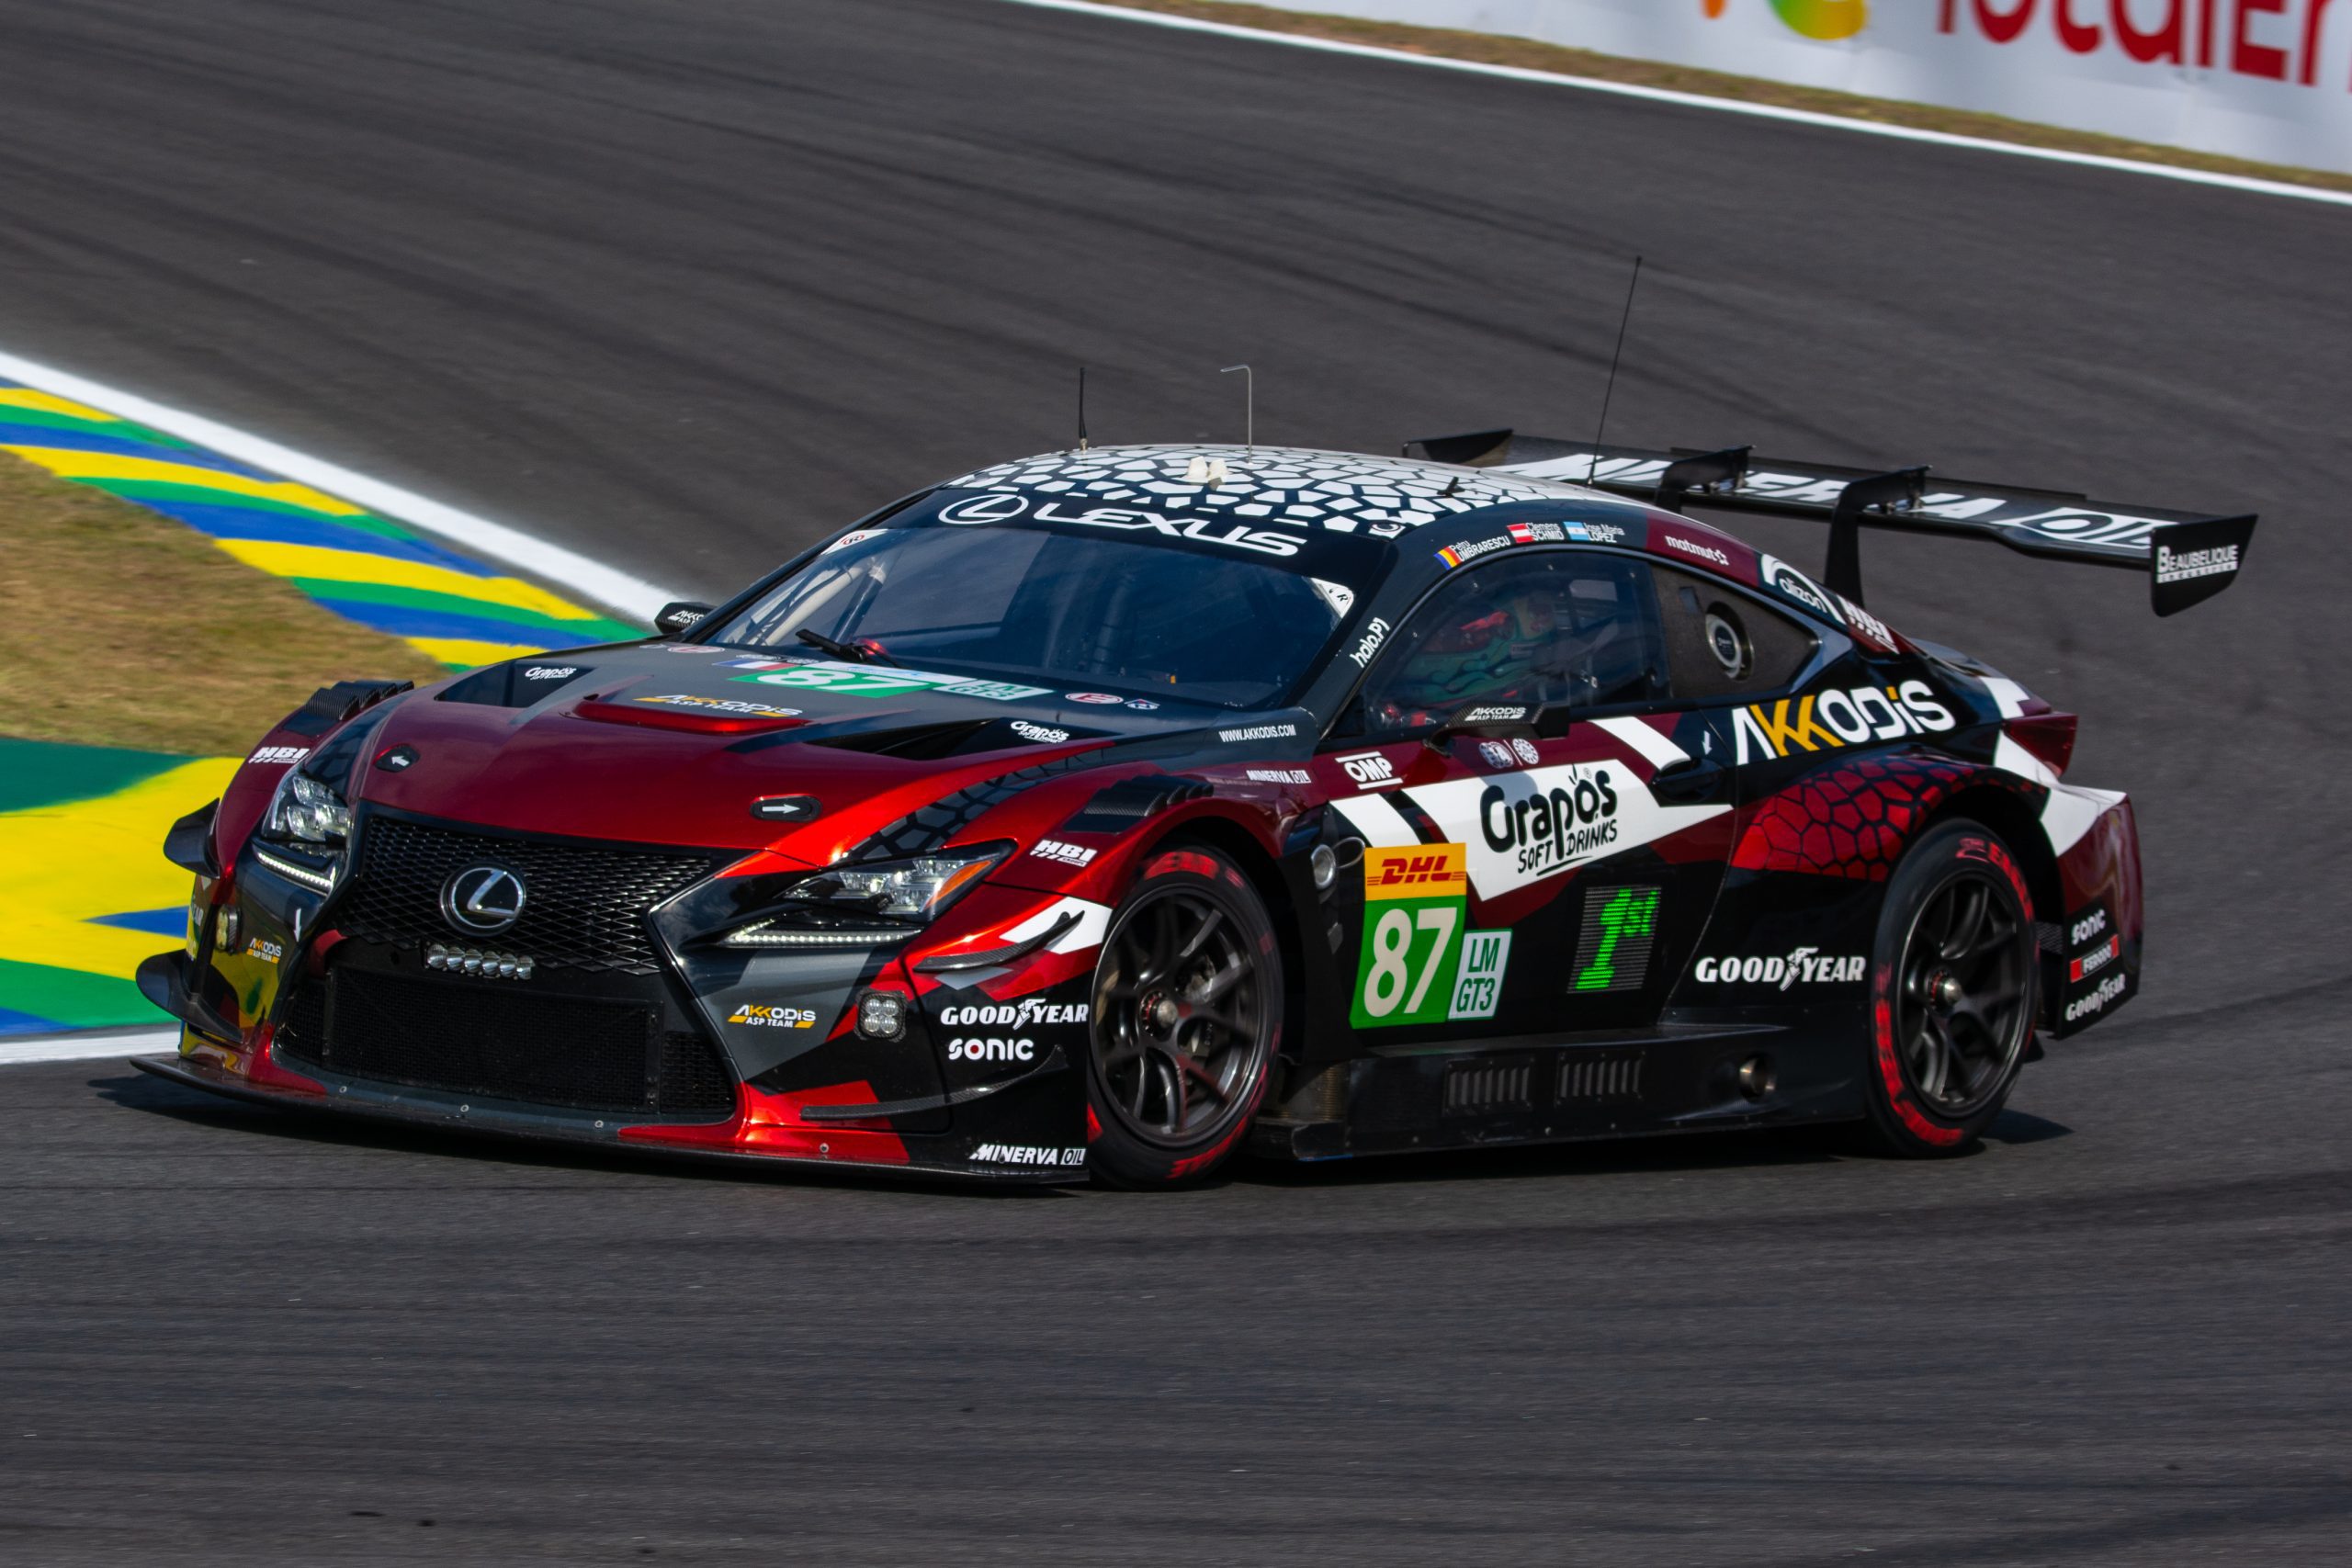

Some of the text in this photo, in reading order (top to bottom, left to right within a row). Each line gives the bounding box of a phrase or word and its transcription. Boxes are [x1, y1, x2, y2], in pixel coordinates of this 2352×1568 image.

[1033, 502, 1308, 557] LEXUS
[1532, 529, 1565, 541] SCHMID
[1665, 535, 1718, 562] matmut
[757, 670, 929, 691] 87
[1218, 724, 1297, 743] WWW.AKKODIS.COM
[253, 746, 311, 759] HBI
[1246, 769, 1293, 784] MINERVA
[1290, 769, 1311, 784] OIL
[1344, 756, 1393, 783] OMP
[1034, 839, 1098, 863] HBI
[1517, 818, 1618, 874] SOFT DRINKS
[1380, 855, 1452, 886] DHL
[1363, 907, 1458, 1018] 87
[1467, 937, 1501, 974] LM
[1695, 950, 1867, 988] GOODYEAR
[1455, 976, 1497, 1013] GT3
[745, 1016, 794, 1028] ASP TEAM
[940, 999, 1090, 1029] GOODYEAR
[968, 1144, 1086, 1166] MINERVA OIL
